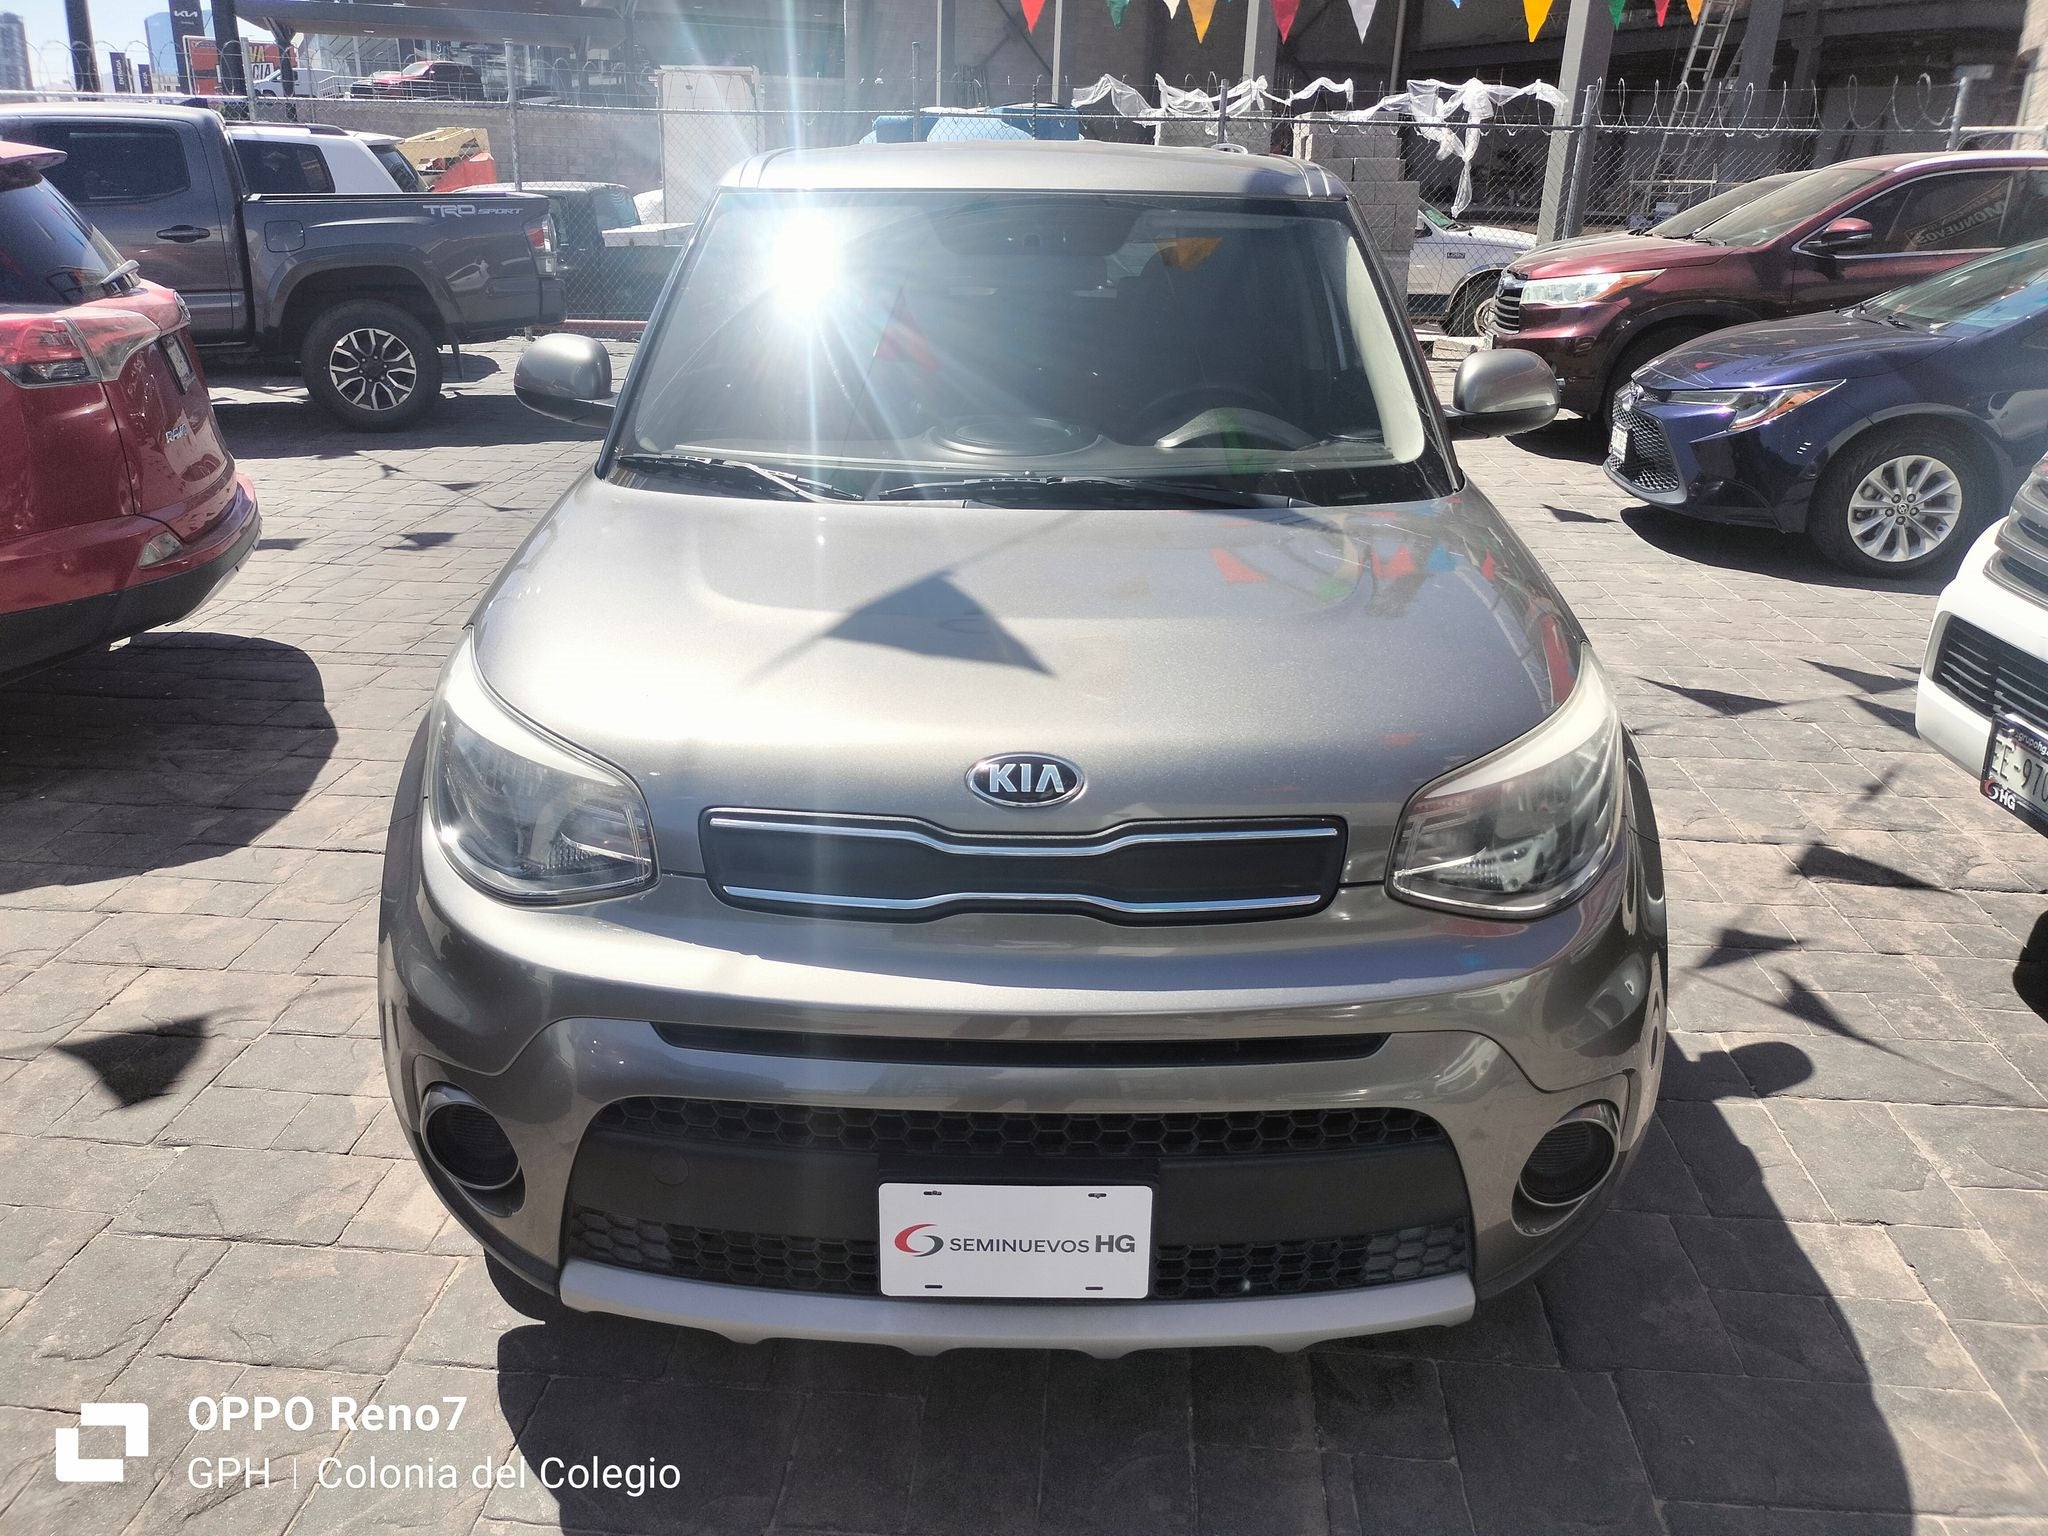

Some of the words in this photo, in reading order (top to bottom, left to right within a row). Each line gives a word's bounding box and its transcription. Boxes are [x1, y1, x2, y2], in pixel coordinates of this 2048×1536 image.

[423, 205, 475, 217] TRD
[987, 763, 1065, 793] KIA
[2000, 788, 2016, 811] HG
[949, 1238, 1089, 1253] SEMINUEVOS
[1095, 1234, 1135, 1253] HG
